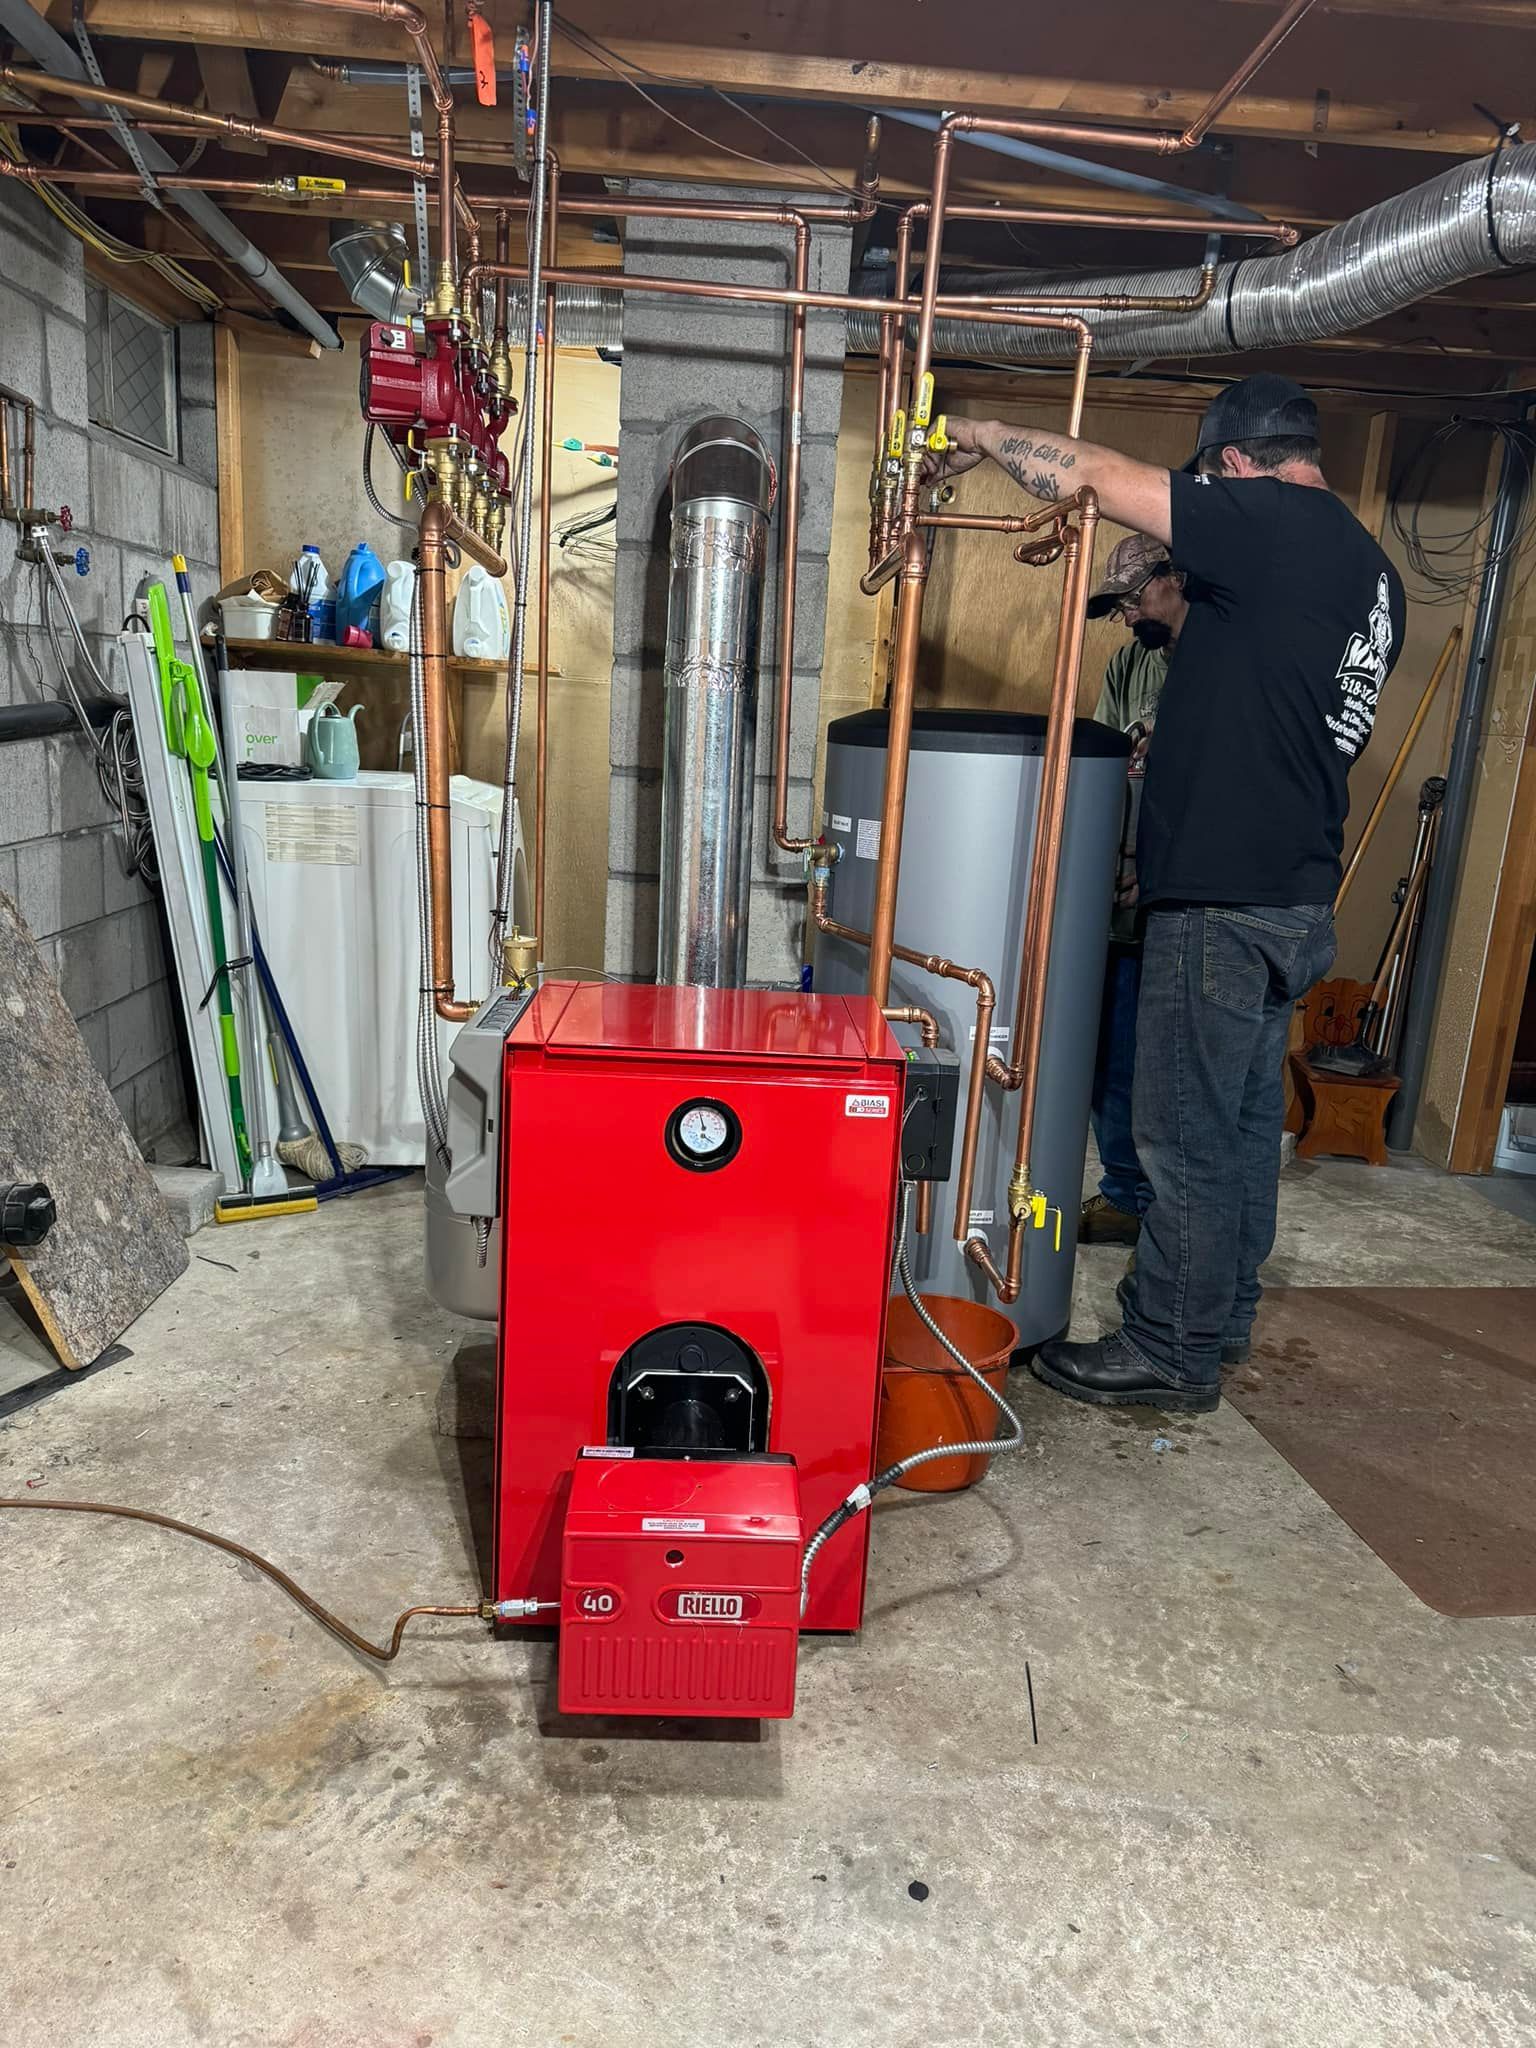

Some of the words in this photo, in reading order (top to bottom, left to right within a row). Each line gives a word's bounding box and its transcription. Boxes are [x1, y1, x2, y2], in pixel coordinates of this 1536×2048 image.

[1000, 438, 1032, 460] NEVER
[1033, 444, 1061, 463] GIVE
[246, 734, 278, 745] over
[583, 1594, 613, 1612] 40
[682, 1597, 738, 1616] RIELLO
